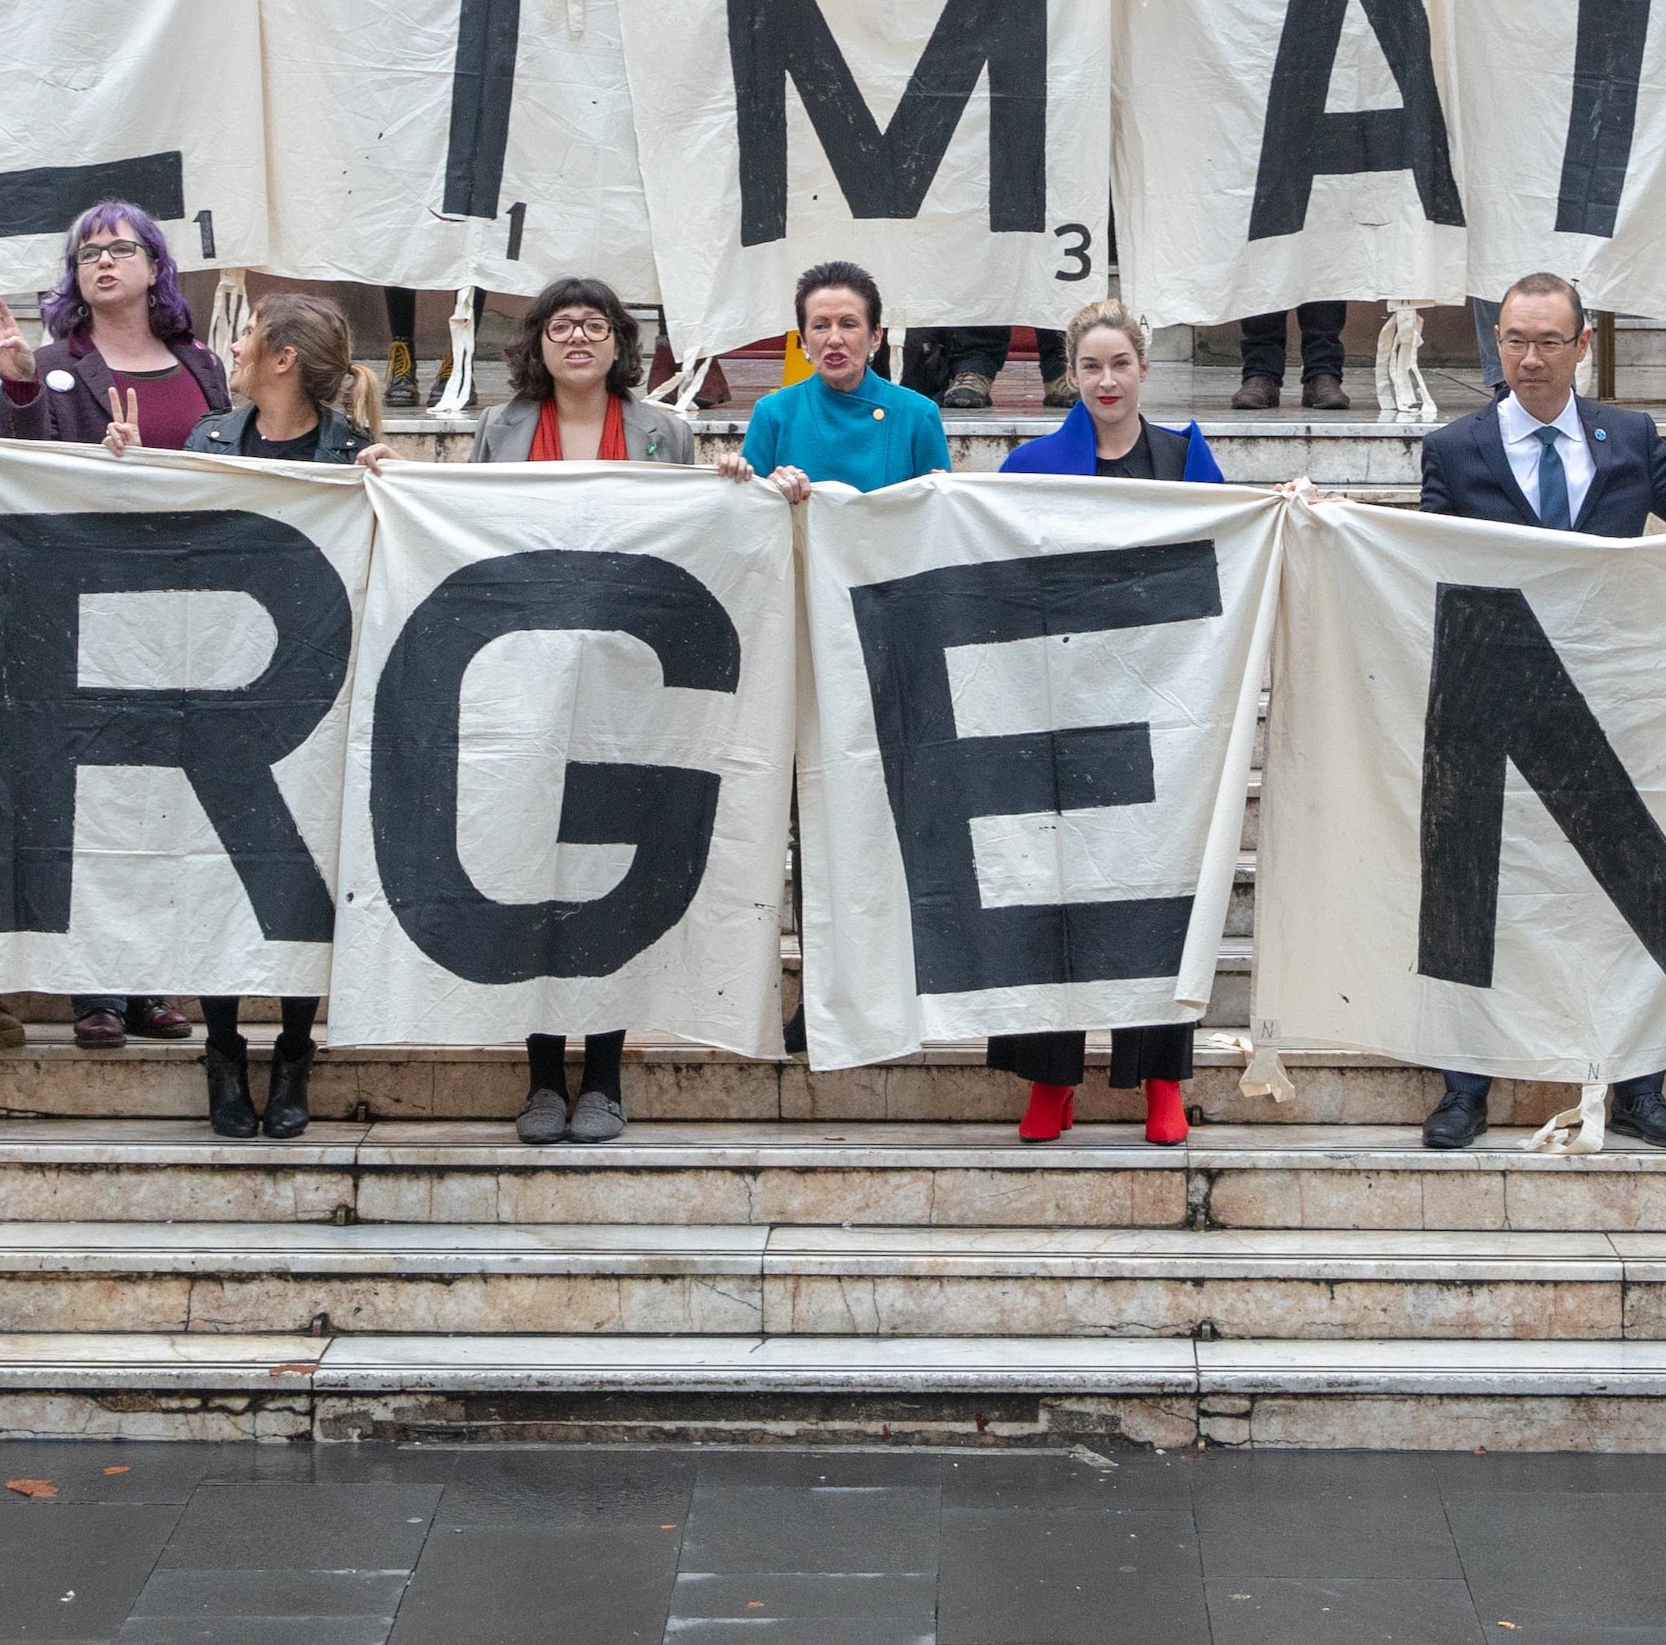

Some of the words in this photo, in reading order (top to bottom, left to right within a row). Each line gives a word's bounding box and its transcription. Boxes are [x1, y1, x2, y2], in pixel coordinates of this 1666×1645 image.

[193, 209, 217, 260] 1
[505, 201, 528, 261] 1
[1053, 223, 1092, 282] 3
[1139, 313, 1151, 331] A
